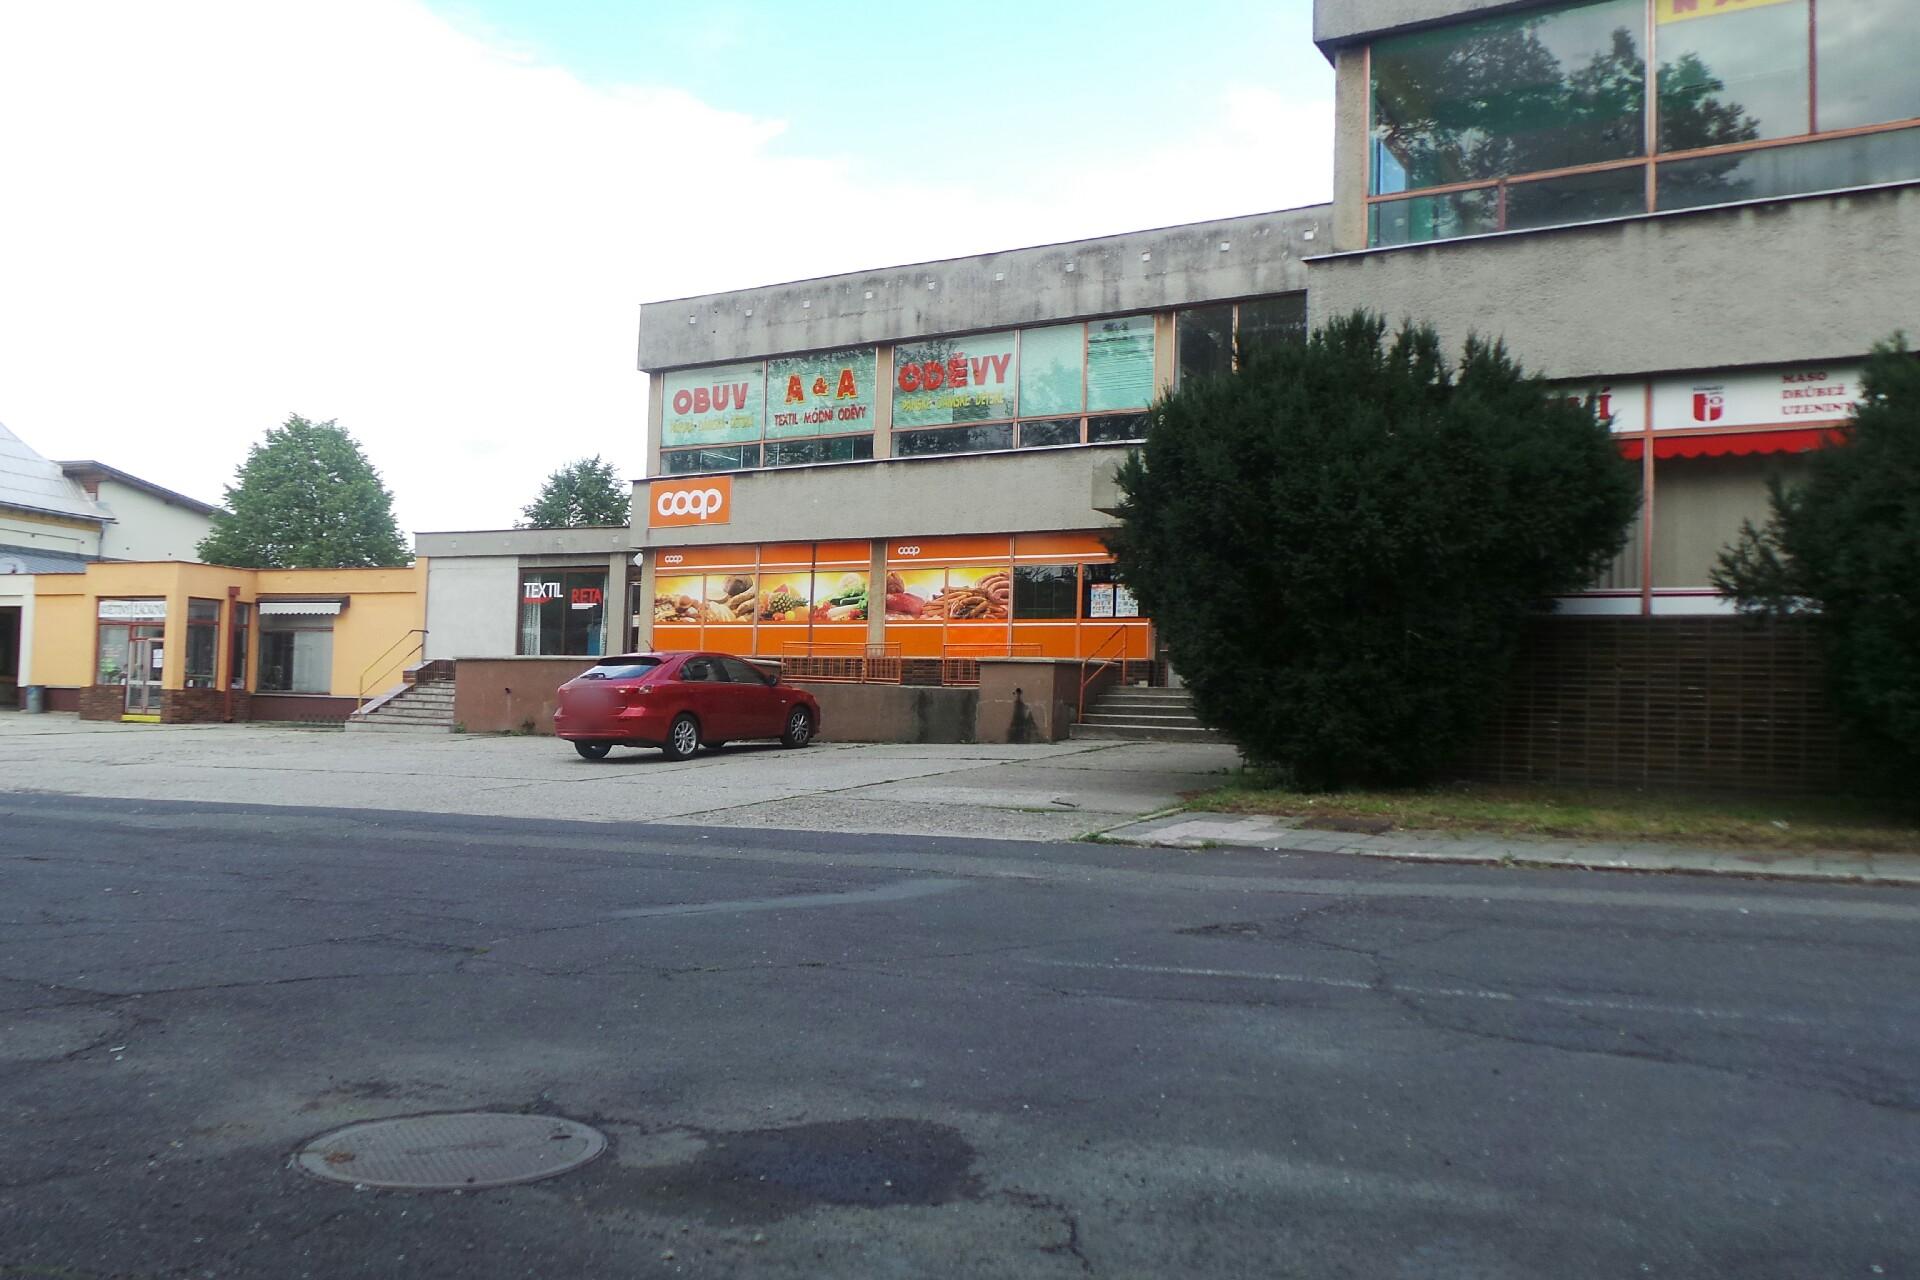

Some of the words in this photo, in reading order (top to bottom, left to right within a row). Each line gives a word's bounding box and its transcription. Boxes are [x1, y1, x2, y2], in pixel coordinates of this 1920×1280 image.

[784, 373, 805, 404] A
[812, 376, 828, 396] &
[837, 368, 858, 399] A
[673, 383, 749, 415] OBUV
[774, 413, 799, 426] TEXTIL
[657, 488, 722, 520] coop
[898, 546, 920, 556] coop
[664, 555, 683, 564] coop
[523, 582, 564, 598] TEXTIL
